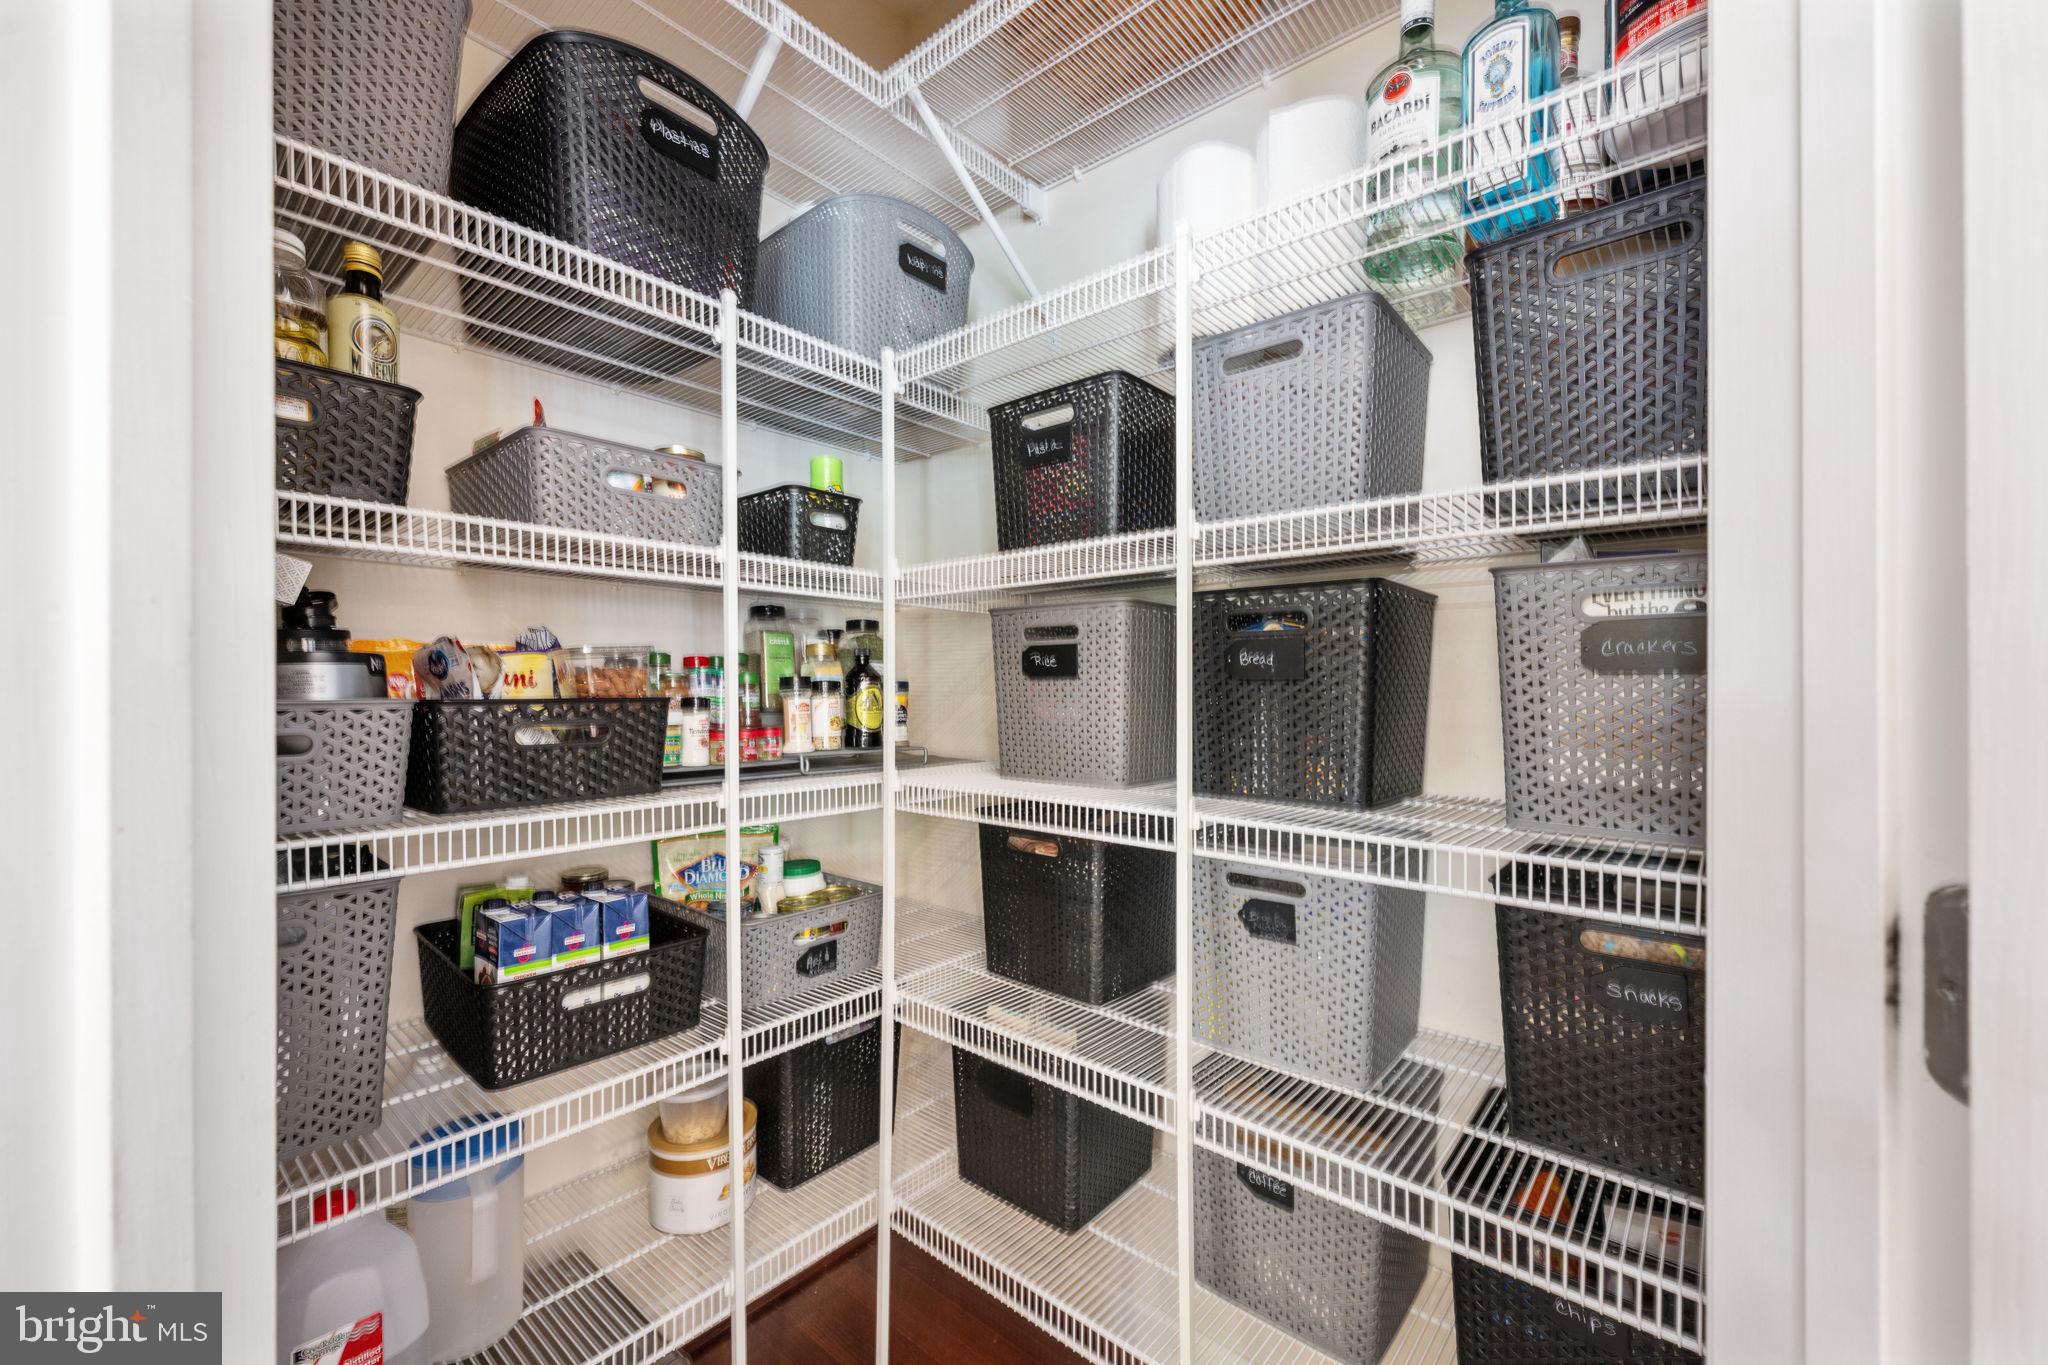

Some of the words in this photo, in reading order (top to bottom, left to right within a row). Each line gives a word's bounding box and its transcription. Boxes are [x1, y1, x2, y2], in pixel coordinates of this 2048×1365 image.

[1370, 93, 1431, 136] BACARDÍ
[1239, 648, 1274, 667] Bread
[701, 856, 728, 873] BLU
[1606, 983, 1683, 1012] Snacks
